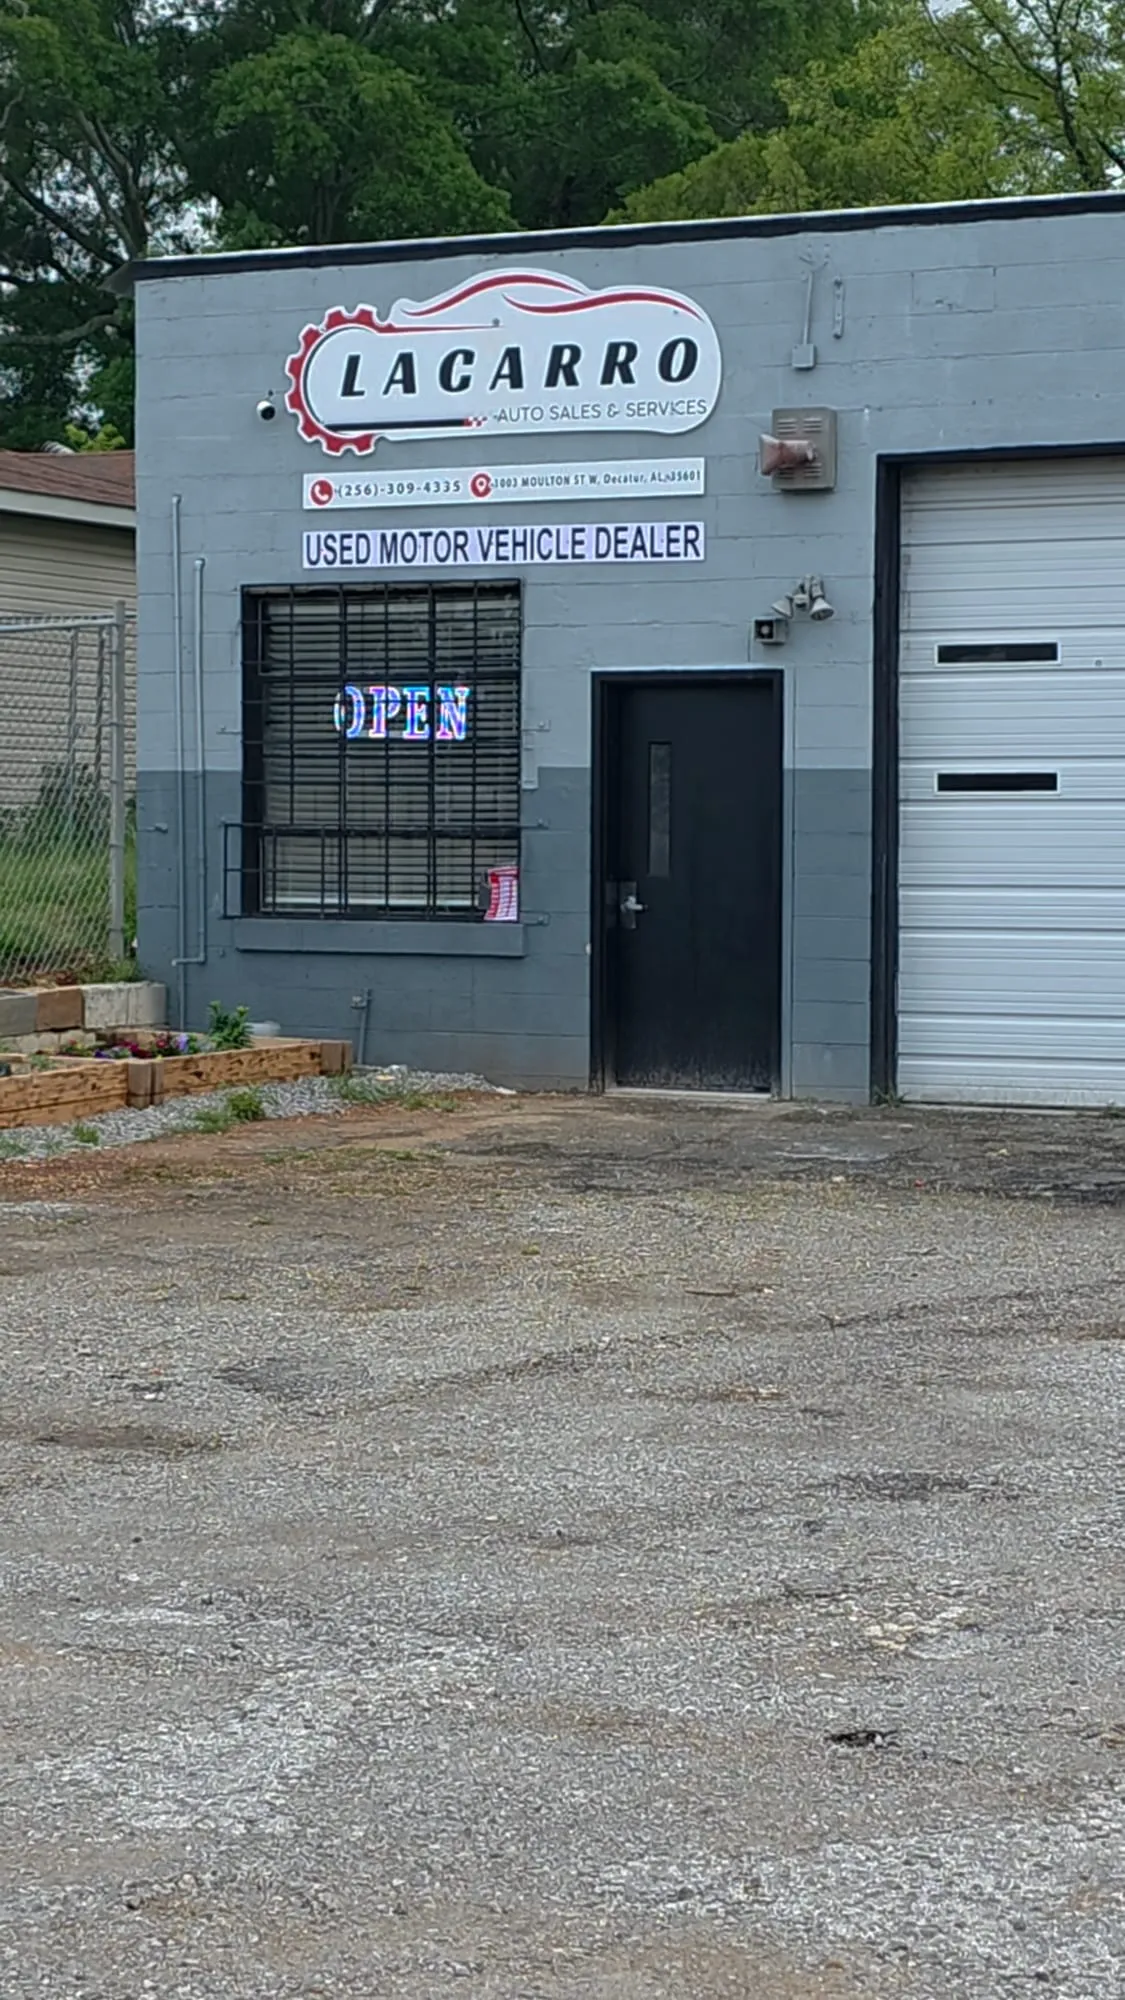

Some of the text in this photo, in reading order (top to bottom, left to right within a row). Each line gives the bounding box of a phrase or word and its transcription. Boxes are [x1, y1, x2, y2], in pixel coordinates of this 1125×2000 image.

[340, 337, 699, 397] LACARRO
[497, 400, 707, 422] AUTO SALES & SERVICES
[338, 480, 461, 498] (256)-309-4335
[494, 478, 518, 488] 1003
[522, 475, 570, 487] MOULTON
[574, 474, 585, 485] ST
[306, 525, 700, 565] USED MOTOR VEHICLE DEALER
[334, 682, 470, 740] OPEN
